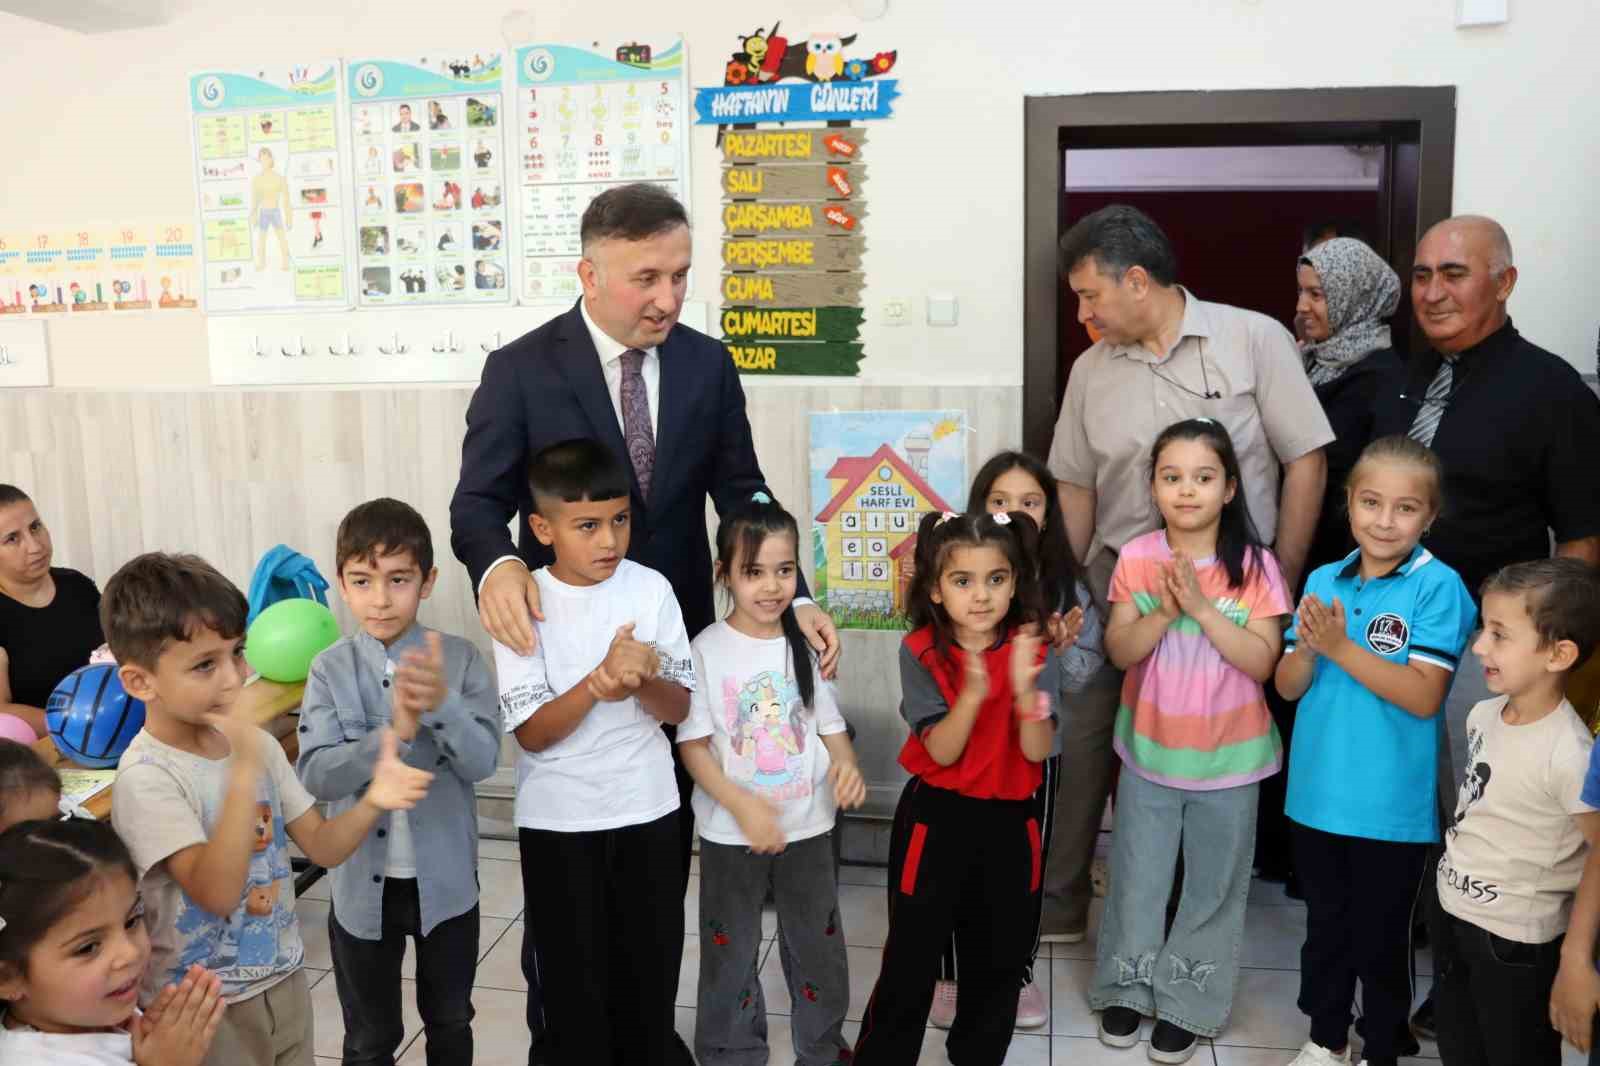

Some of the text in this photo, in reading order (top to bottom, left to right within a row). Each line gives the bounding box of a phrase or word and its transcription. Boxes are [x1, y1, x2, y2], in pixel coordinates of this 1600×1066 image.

[660, 82, 668, 95] 5
[530, 137, 538, 149] 6
[595, 134, 603, 146] 8
[726, 204, 812, 232] ÇARŞAMBA
[38, 234, 48, 249] 17
[77, 232, 89, 247] 18
[166, 227, 183, 242] 20
[726, 241, 815, 268] PERŞEMBE
[726, 276, 774, 300] CUMA
[724, 308, 816, 336] CUMARTESİ
[870, 485, 902, 496] SESLİ
[861, 496, 915, 508] HARF EVİ
[894, 515, 905, 528] u
[848, 542, 882, 553] e o
[872, 562, 883, 577] ö
[1448, 868, 1498, 904] CLASS
